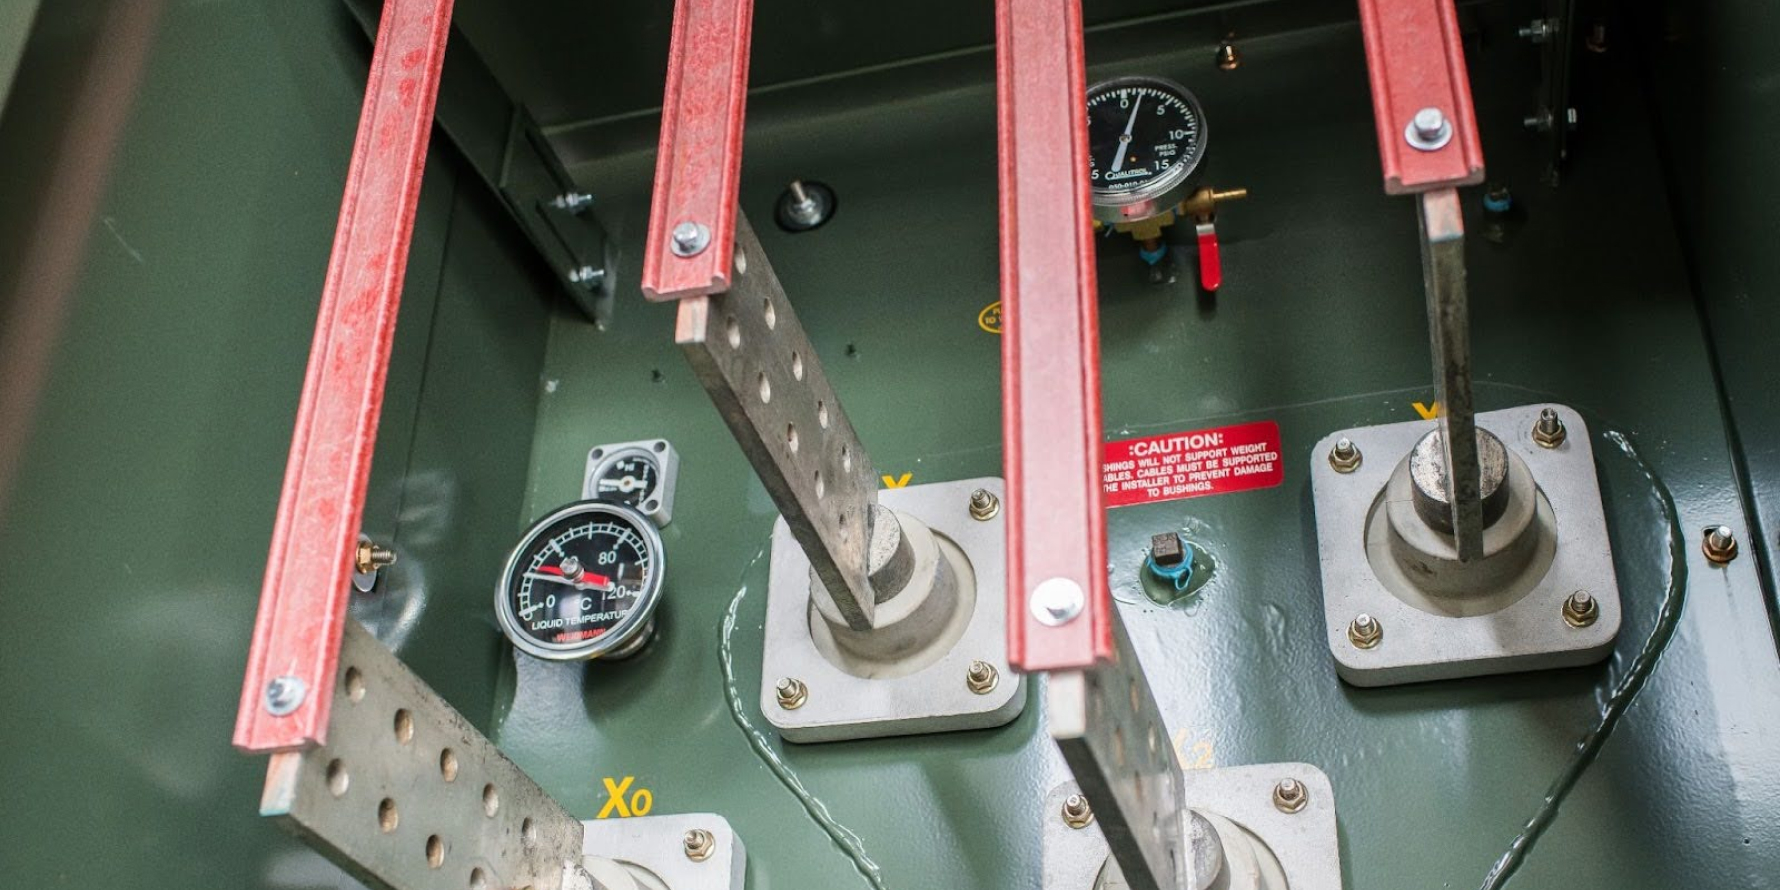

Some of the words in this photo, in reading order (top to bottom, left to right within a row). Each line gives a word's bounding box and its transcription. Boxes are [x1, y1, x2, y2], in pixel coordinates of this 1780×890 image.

[1120, 99, 1129, 109] 0
[1156, 105, 1166, 115] 5
[1169, 129, 1184, 140] 10
[1154, 159, 1170, 171] 15
[1138, 456, 1160, 469] WILL
[1163, 454, 1181, 465] NOT
[1185, 447, 1227, 462] SUPPORT
[1230, 442, 1267, 455] WEIGHT
[1137, 466, 1173, 479] CABLES
[1176, 461, 1203, 473] MUST
[1206, 459, 1219, 470] BE
[1222, 451, 1278, 468] SUPPORTED
[1121, 475, 1170, 490] INSTALLER
[1173, 473, 1186, 484] TO
[1189, 468, 1231, 482] PREVENT
[1234, 462, 1273, 476] DAMAGE
[1147, 486, 1160, 498] TO
[1163, 481, 1214, 496] BUSHINGS.
[598, 550, 617, 565] 80
[546, 595, 556, 609] 0
[531, 617, 563, 631] LIQUID
